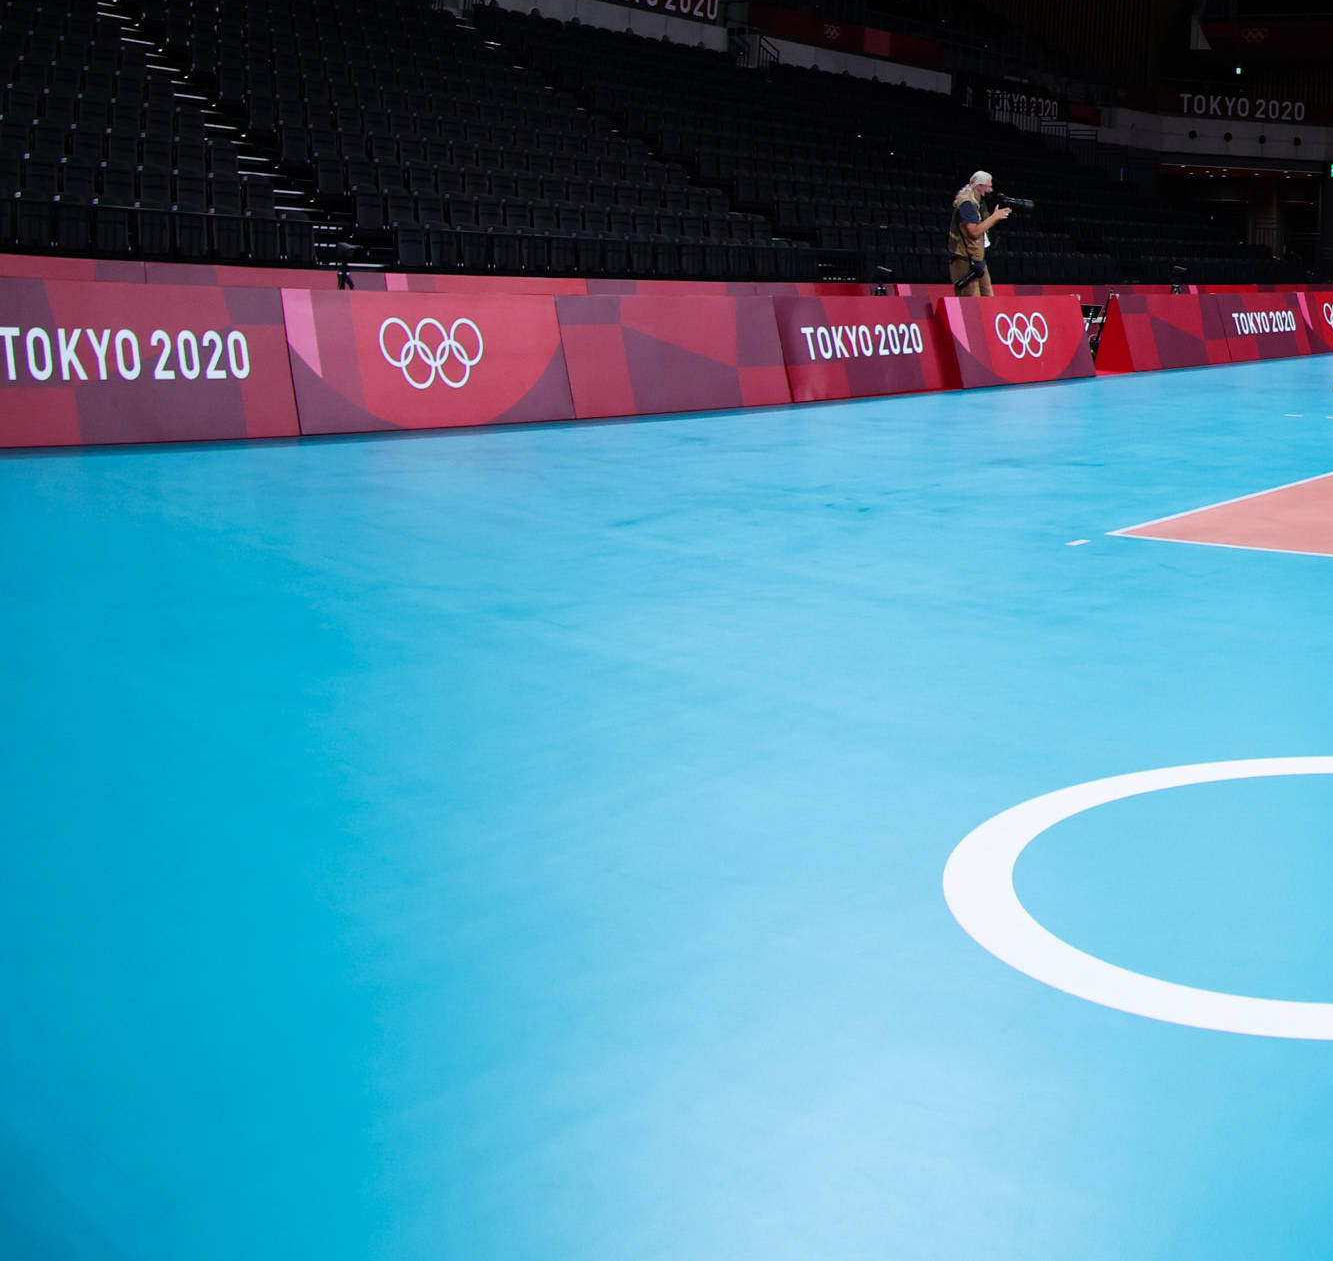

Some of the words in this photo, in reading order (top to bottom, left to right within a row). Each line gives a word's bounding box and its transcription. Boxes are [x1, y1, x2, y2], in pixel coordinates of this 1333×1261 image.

[985, 88, 1028, 114] TOKYO
[1179, 92, 1250, 118] TOKYO
[1254, 98, 1305, 122] 2020
[1231, 311, 1270, 335] TOKYO
[1269, 310, 1296, 333] 2020
[0, 326, 142, 381] TOKYO
[149, 329, 251, 380] 2020
[800, 324, 874, 360] TOKYO
[874, 323, 924, 356] 2020
